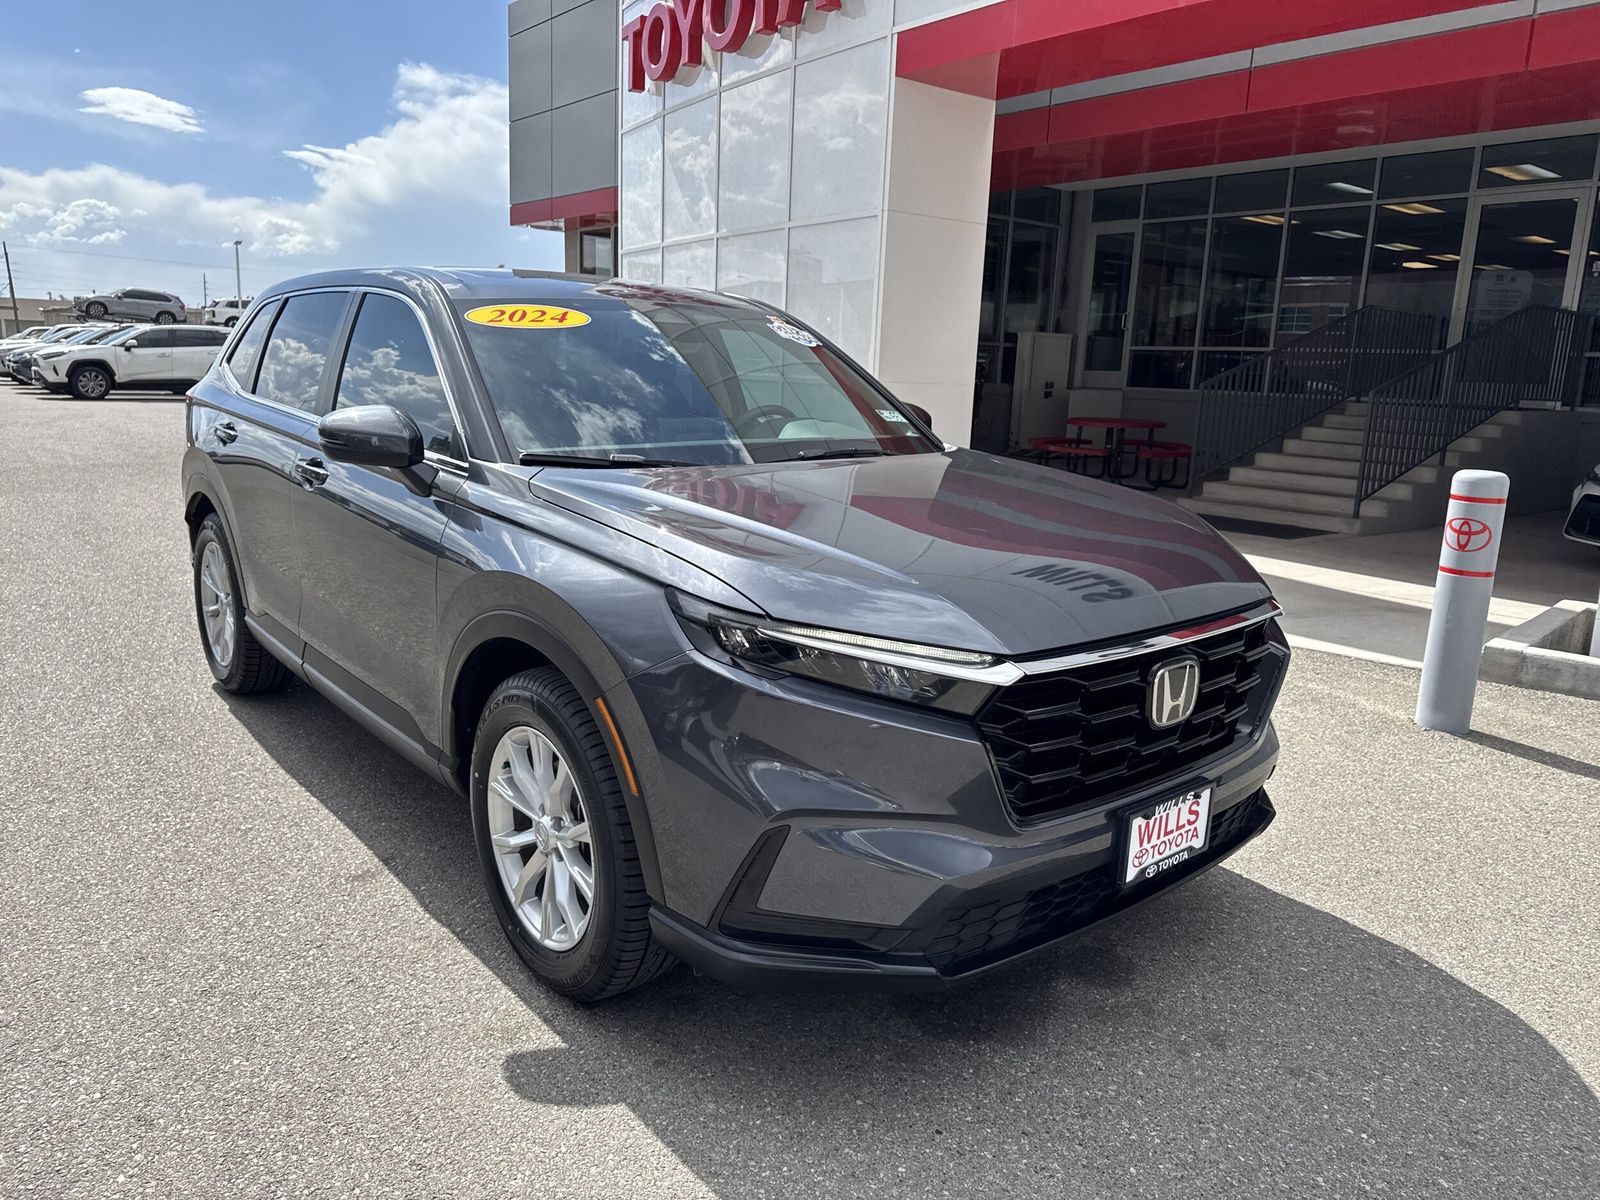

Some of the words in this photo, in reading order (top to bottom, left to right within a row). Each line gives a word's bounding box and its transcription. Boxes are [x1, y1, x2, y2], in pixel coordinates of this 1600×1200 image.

[622, 0, 842, 93] TOYO
[487, 309, 569, 323] 2024
[1138, 800, 1200, 848] WILLS
[1150, 827, 1199, 859] TOYOTA
[1158, 850, 1188, 871] TOYOTA
